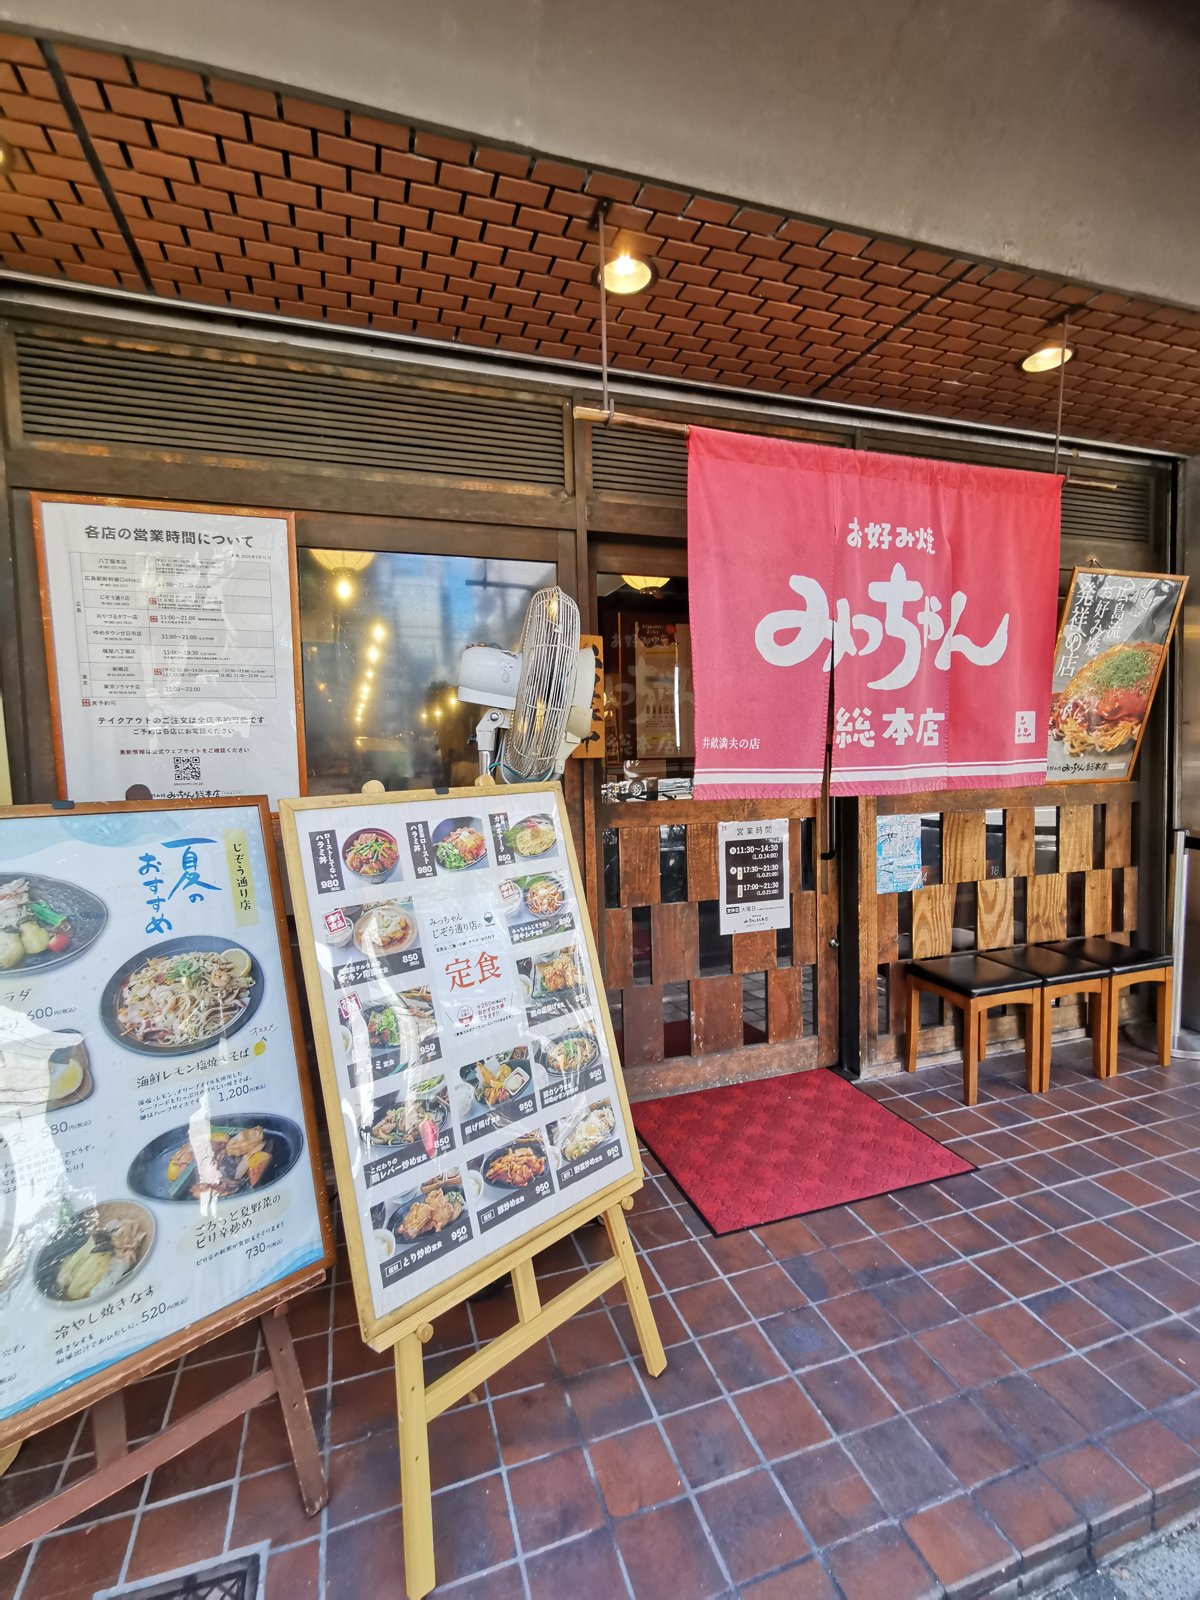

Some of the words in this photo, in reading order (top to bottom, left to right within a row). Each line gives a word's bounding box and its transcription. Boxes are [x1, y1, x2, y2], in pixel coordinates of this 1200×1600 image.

[84, 525, 254, 548] 各店の営業時間について
[847, 517, 935, 555] お好み焼
[755, 562, 1009, 690] みっちゃん
[1055, 583, 1097, 678] 発祥の店
[834, 706, 946, 749] 総本店
[410, 826, 421, 853] ハラミ丼
[737, 825, 773, 836] 営業時間
[315, 841, 328, 866] ハラミ丼
[324, 834, 338, 880] ローストしてない
[736, 844, 780, 854] 11:30～14:30
[161, 837, 222, 904] 夏の
[233, 843, 252, 911] じぞう通り店
[416, 866, 433, 876] 980
[743, 864, 779, 874] 17:30～21:30
[138, 853, 173, 934] おすすめ
[320, 880, 339, 889] 980
[744, 882, 779, 891] 17:00～21:30
[430, 912, 463, 927] みっちゃん
[432, 919, 483, 939] じぞう通り店の
[402, 953, 419, 964] 850
[445, 951, 503, 994] 定食
[419, 1042, 437, 1056] 950
[137, 1047, 250, 1090] 海鮮レモン塩焼きそば
[589, 1069, 602, 1080] 950
[518, 1100, 533, 1112] 950
[433, 1135, 450, 1149] 850
[606, 1146, 618, 1158] 950
[371, 1157, 398, 1175] こだわりの
[534, 1181, 549, 1194] 950
[194, 1193, 282, 1238] ごろっと夏野菜の
[196, 1217, 253, 1250] ピリ辛炒め
[450, 1225, 468, 1240] 950
[402, 1240, 443, 1267] とり炒め定食
[55, 1284, 155, 1341] 冷やし焼きなす
